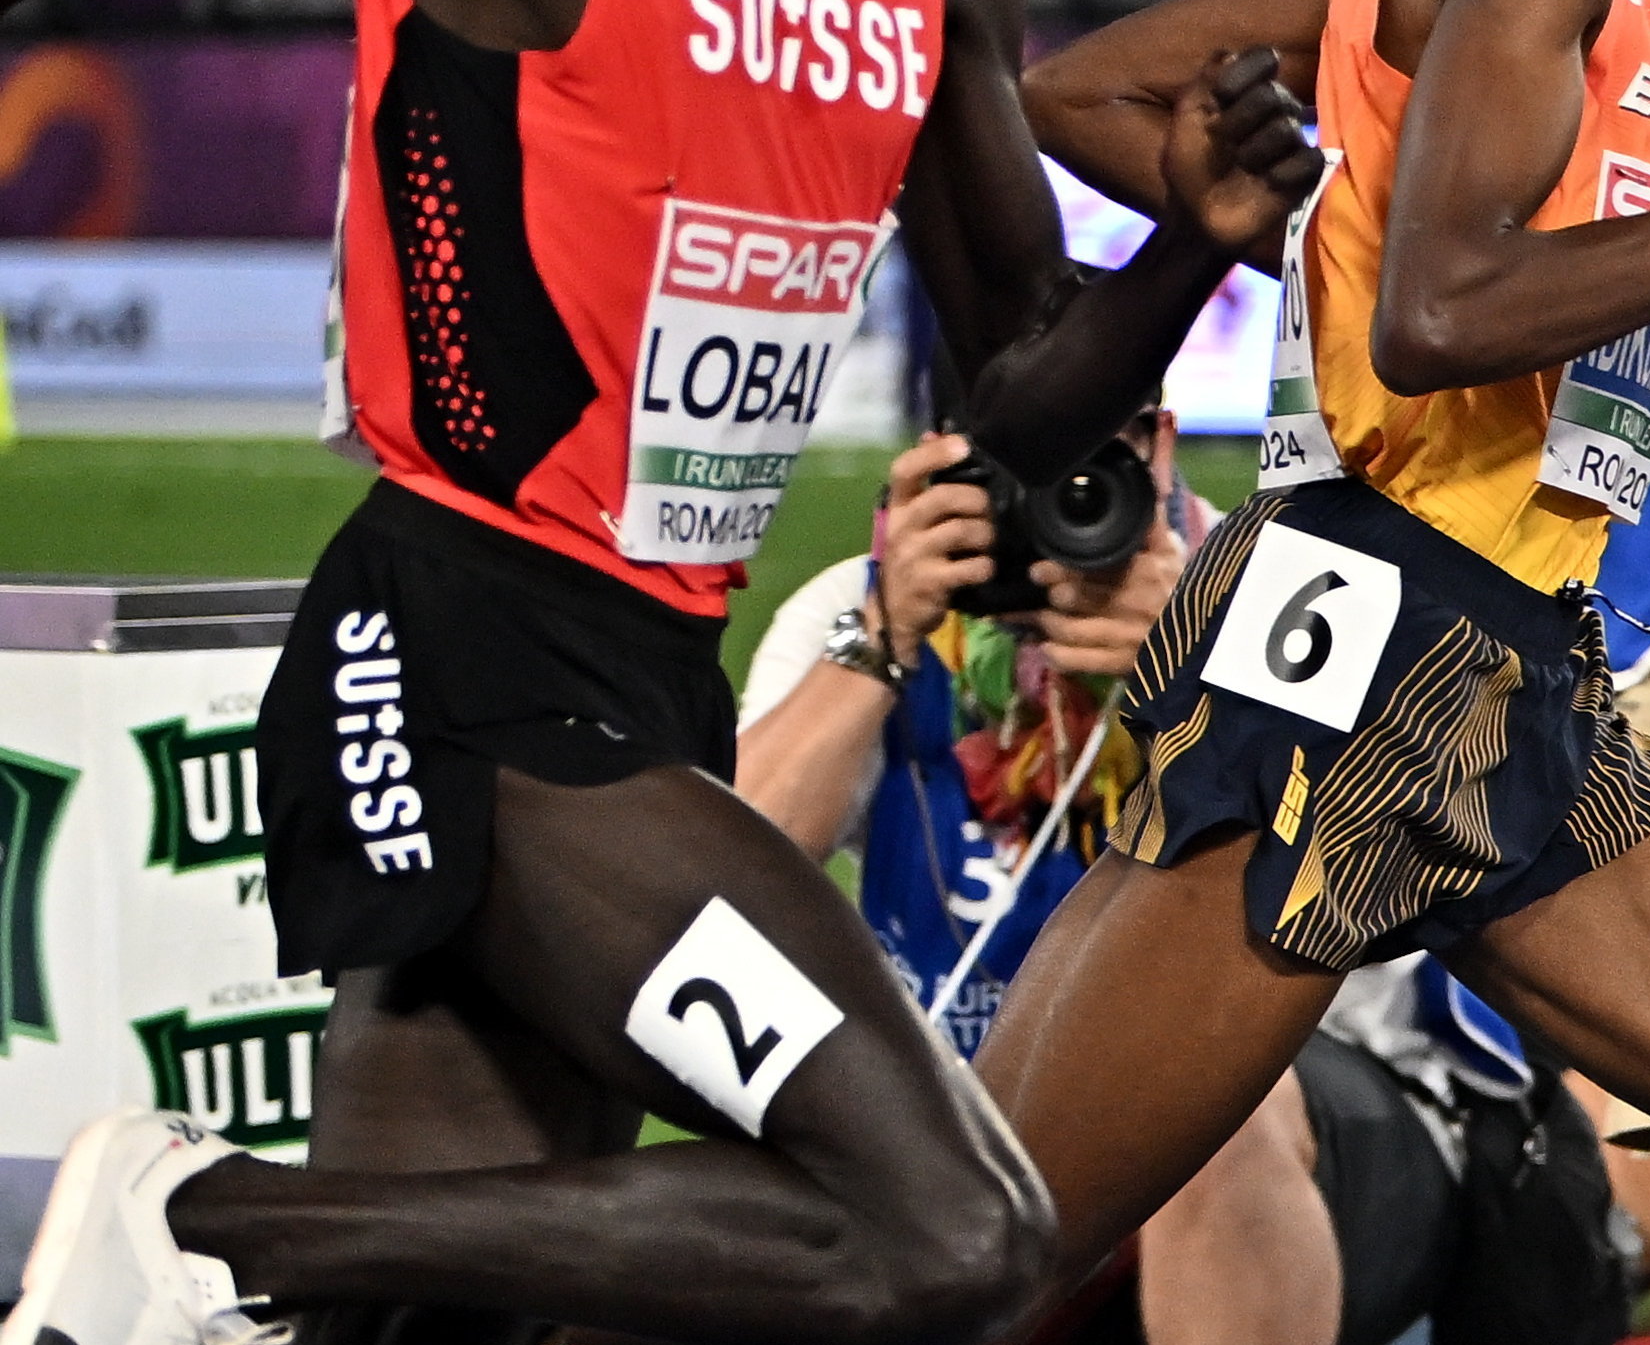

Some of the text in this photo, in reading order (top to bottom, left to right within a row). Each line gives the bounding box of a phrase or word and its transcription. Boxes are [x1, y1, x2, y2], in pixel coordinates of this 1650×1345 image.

[669, 222, 861, 302] SPAR
[684, 454, 747, 487] RUN
[1265, 569, 1351, 684] 6
[1271, 744, 1311, 847] ESP
[667, 976, 784, 1087] 2
